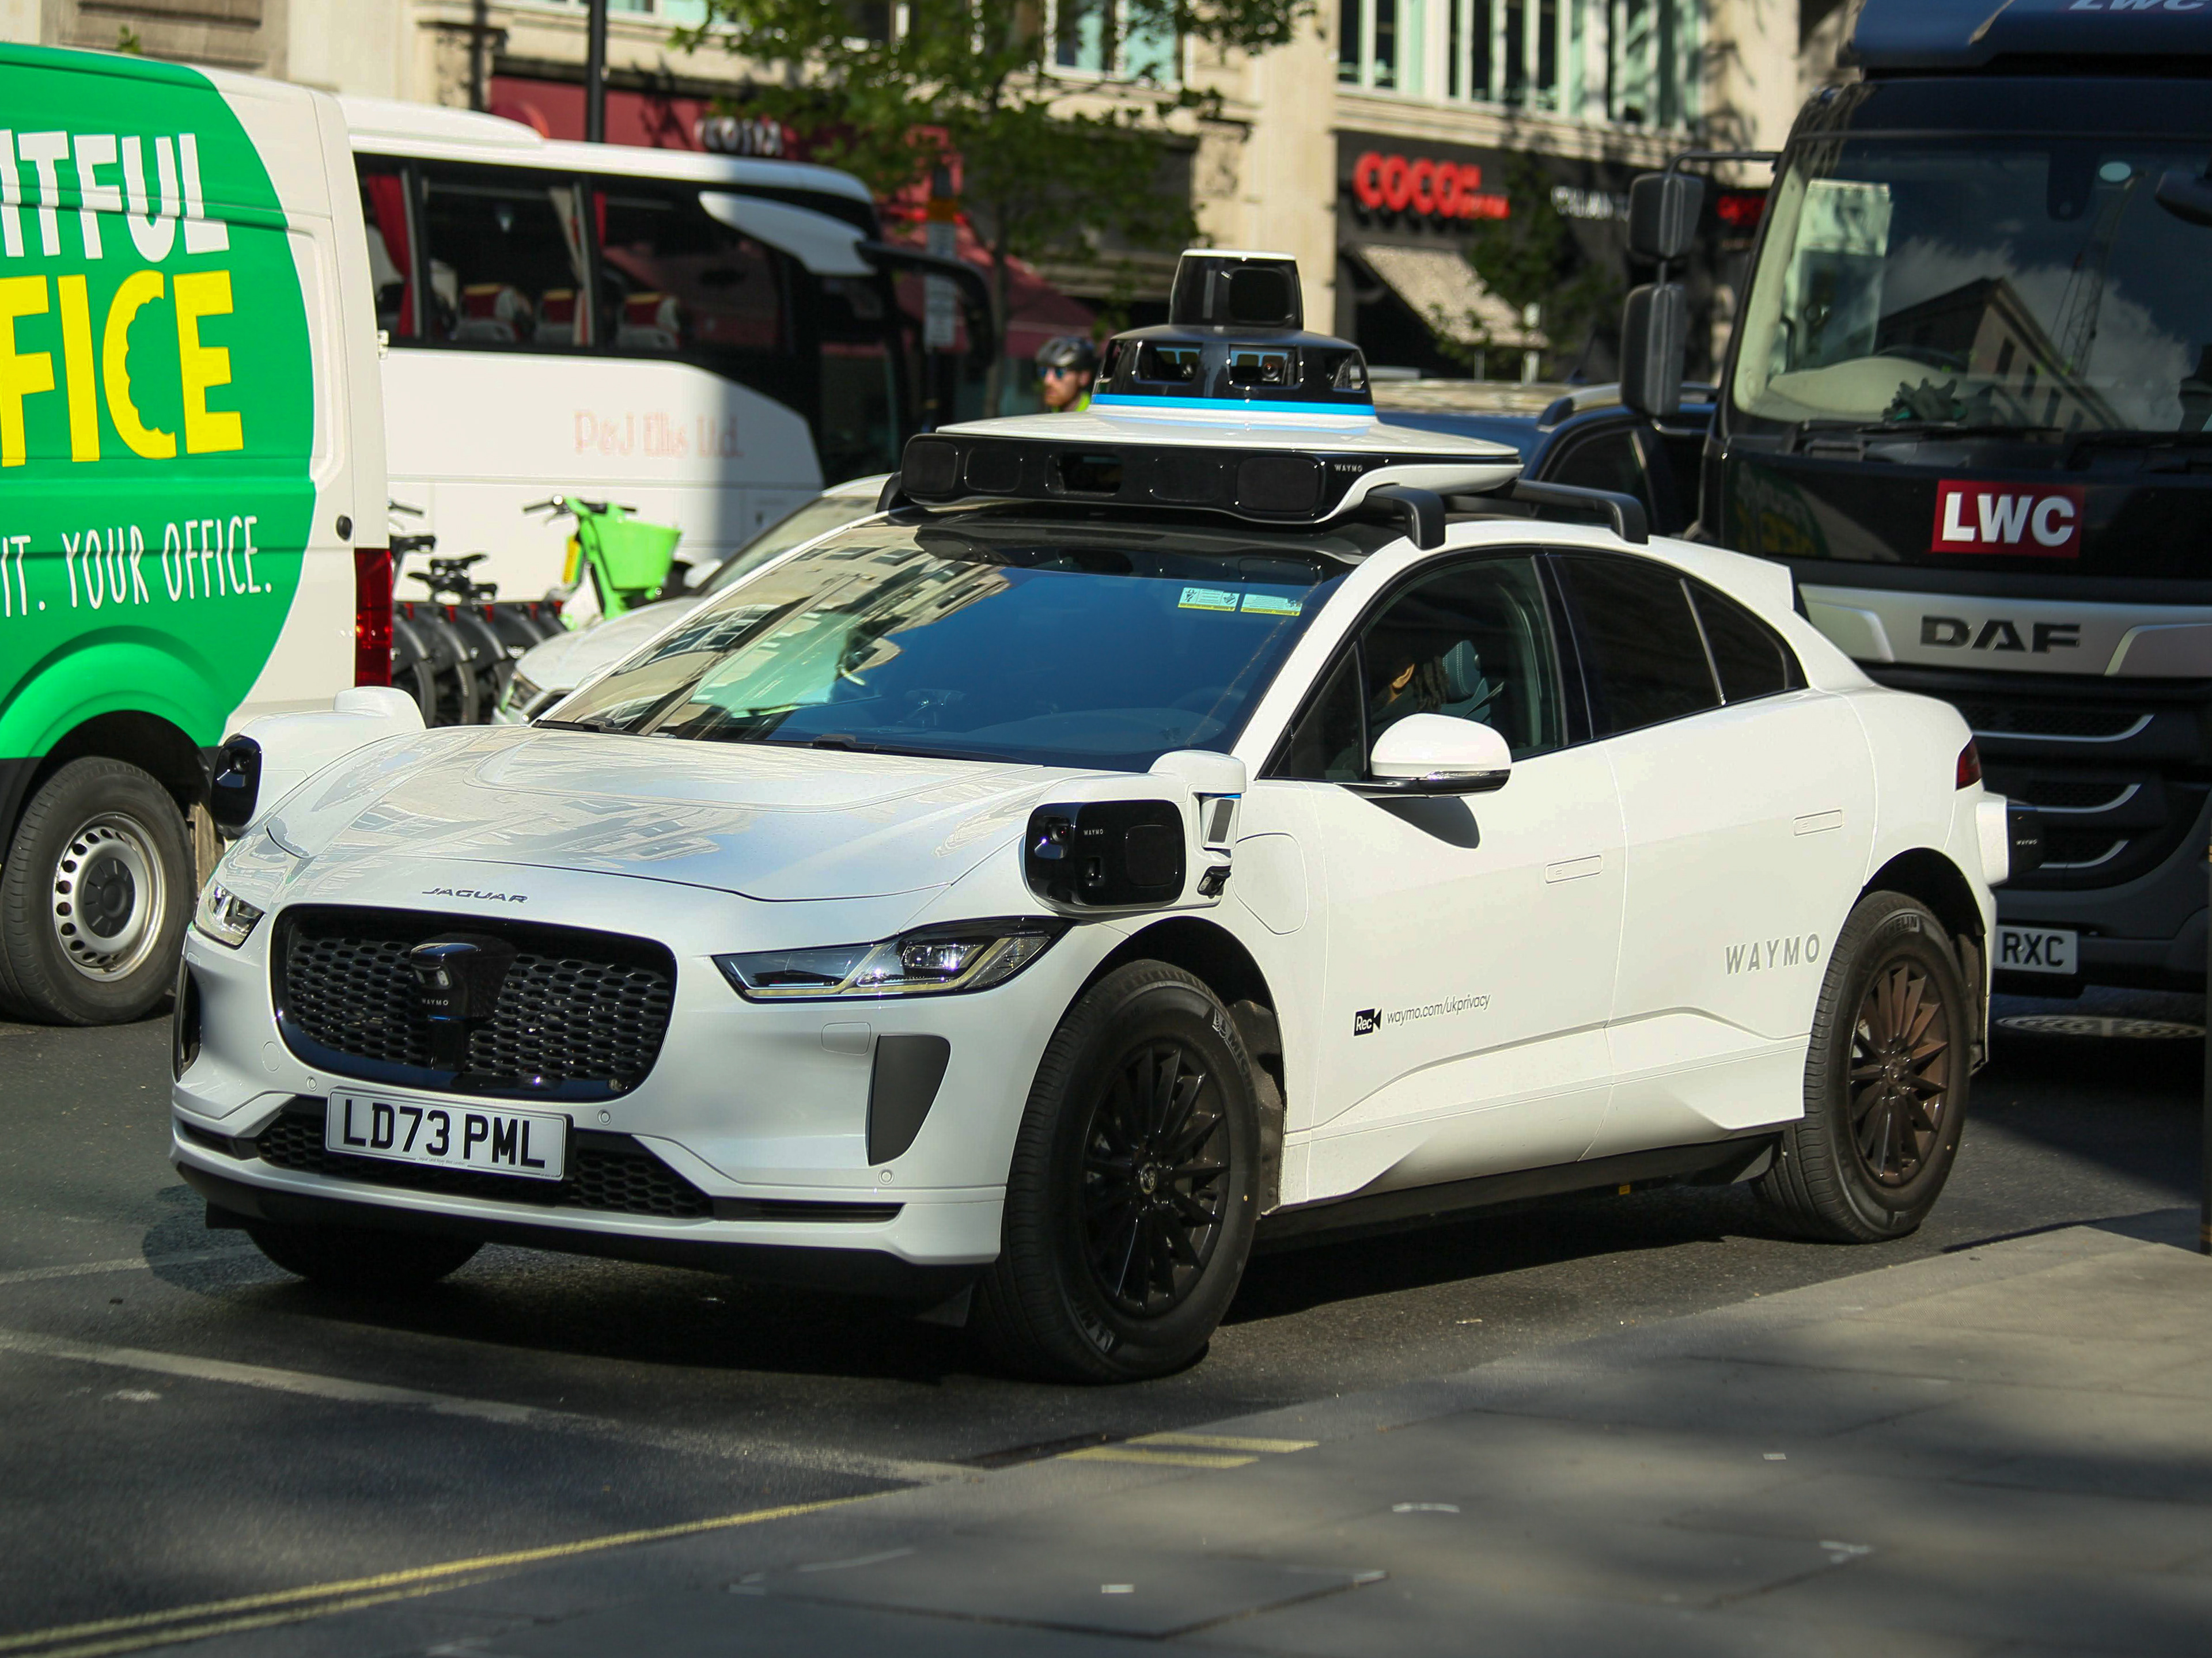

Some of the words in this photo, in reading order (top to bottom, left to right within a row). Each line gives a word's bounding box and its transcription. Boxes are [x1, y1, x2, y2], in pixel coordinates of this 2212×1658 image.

[0, 270, 244, 468] FICE
[1334, 464, 1363, 472] WAYMO
[1942, 492, 2074, 547] LWC
[61, 524, 150, 609] YOUR
[162, 515, 272, 601] OFFICE.
[1920, 616, 2081, 654] DAF
[422, 887, 528, 903] JAGUAR
[1725, 933, 1820, 974] WAYMO
[2002, 932, 2064, 968] RXC
[1355, 1015, 1373, 1031] Rec
[1387, 994, 1491, 1026] waymo.com/ukprivacy
[343, 1099, 451, 1156] LD73
[463, 1113, 546, 1169] PML
